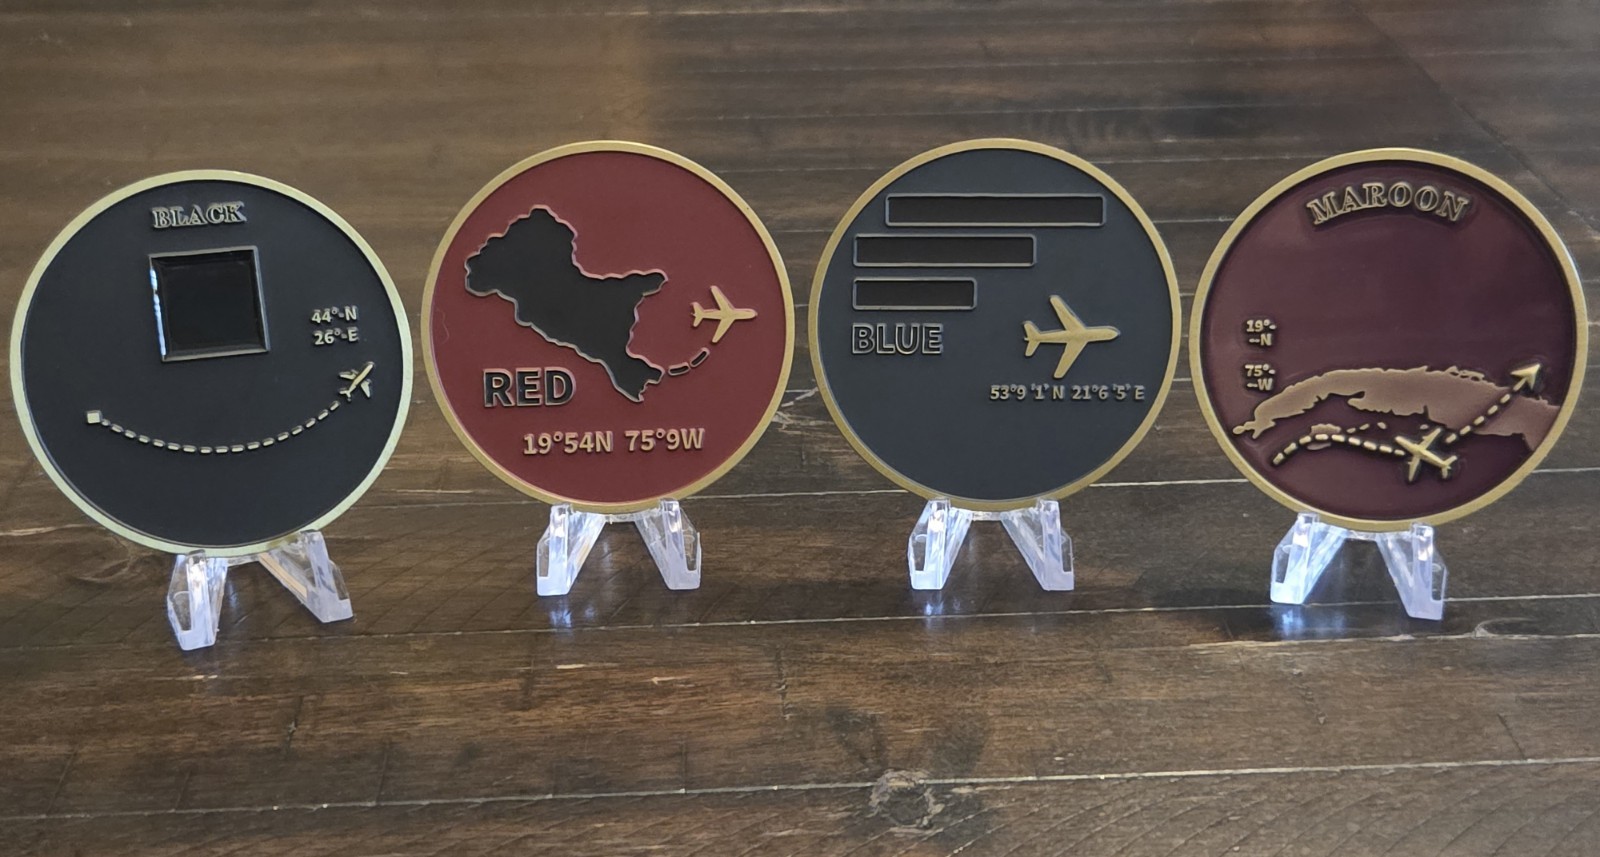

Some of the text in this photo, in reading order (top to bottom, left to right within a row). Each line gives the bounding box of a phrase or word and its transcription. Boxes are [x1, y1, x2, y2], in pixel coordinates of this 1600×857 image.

[151, 201, 247, 229] BLACK
[1306, 181, 1469, 225] MAROON
[852, 323, 943, 355] BLUE
[483, 367, 576, 407] RED
[523, 427, 705, 456] 19°54N 75°9W
